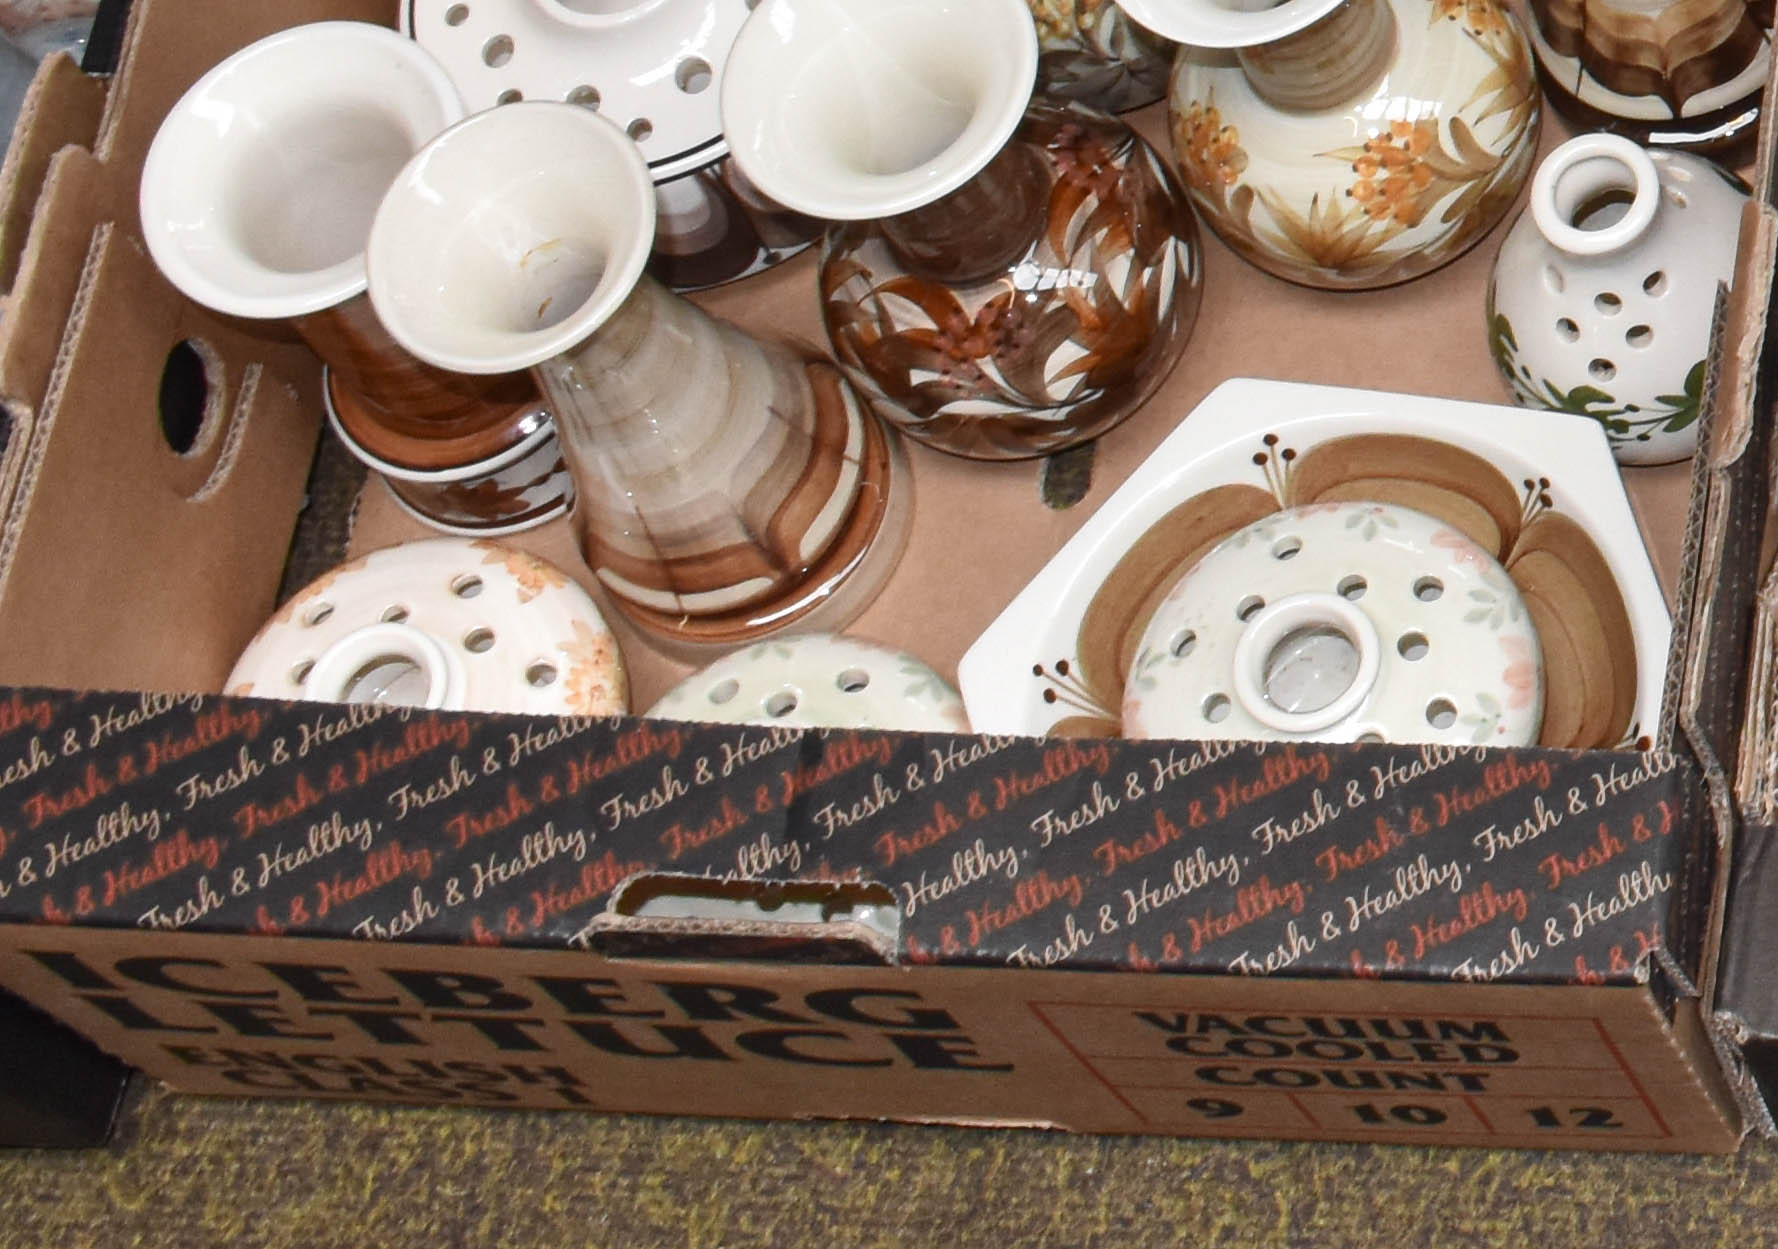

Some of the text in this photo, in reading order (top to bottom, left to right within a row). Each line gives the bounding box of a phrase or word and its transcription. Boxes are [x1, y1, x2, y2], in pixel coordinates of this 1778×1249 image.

[0, 736, 55, 790] esh
[61, 728, 81, 756] &
[18, 856, 38, 886] &
[176, 746, 265, 810] Fresh
[271, 737, 290, 765] &
[231, 867, 250, 896] &
[388, 755, 476, 821] Fresh
[482, 746, 501, 775] &
[446, 876, 465, 905] &
[602, 765, 690, 831] Fresh
[695, 756, 714, 785] &
[813, 773, 900, 839] Fresh
[907, 763, 925, 791] &
[1031, 781, 1120, 847] Fresh
[1126, 772, 1145, 800] &
[1100, 904, 1119, 933] &
[1252, 788, 1340, 855] Fresh
[1346, 779, 1365, 808] &
[1322, 911, 1341, 940] &
[1473, 796, 1562, 862] Fresh
[1568, 787, 1588, 815] &
[1545, 917, 1564, 947] &
[1568, 861, 1671, 938] Health
[20, 951, 961, 1030] ICEBERG
[1133, 1011, 1511, 1042] VACUUM
[75, 994, 1015, 1071] LETTUCE
[160, 1044, 592, 1088] ENGLISH
[1165, 1036, 1520, 1064] COOLED
[219, 1068, 520, 1101] CLASS
[1186, 1097, 1625, 1129] 9 10 12
[1194, 1066, 1490, 1093] COUNT
